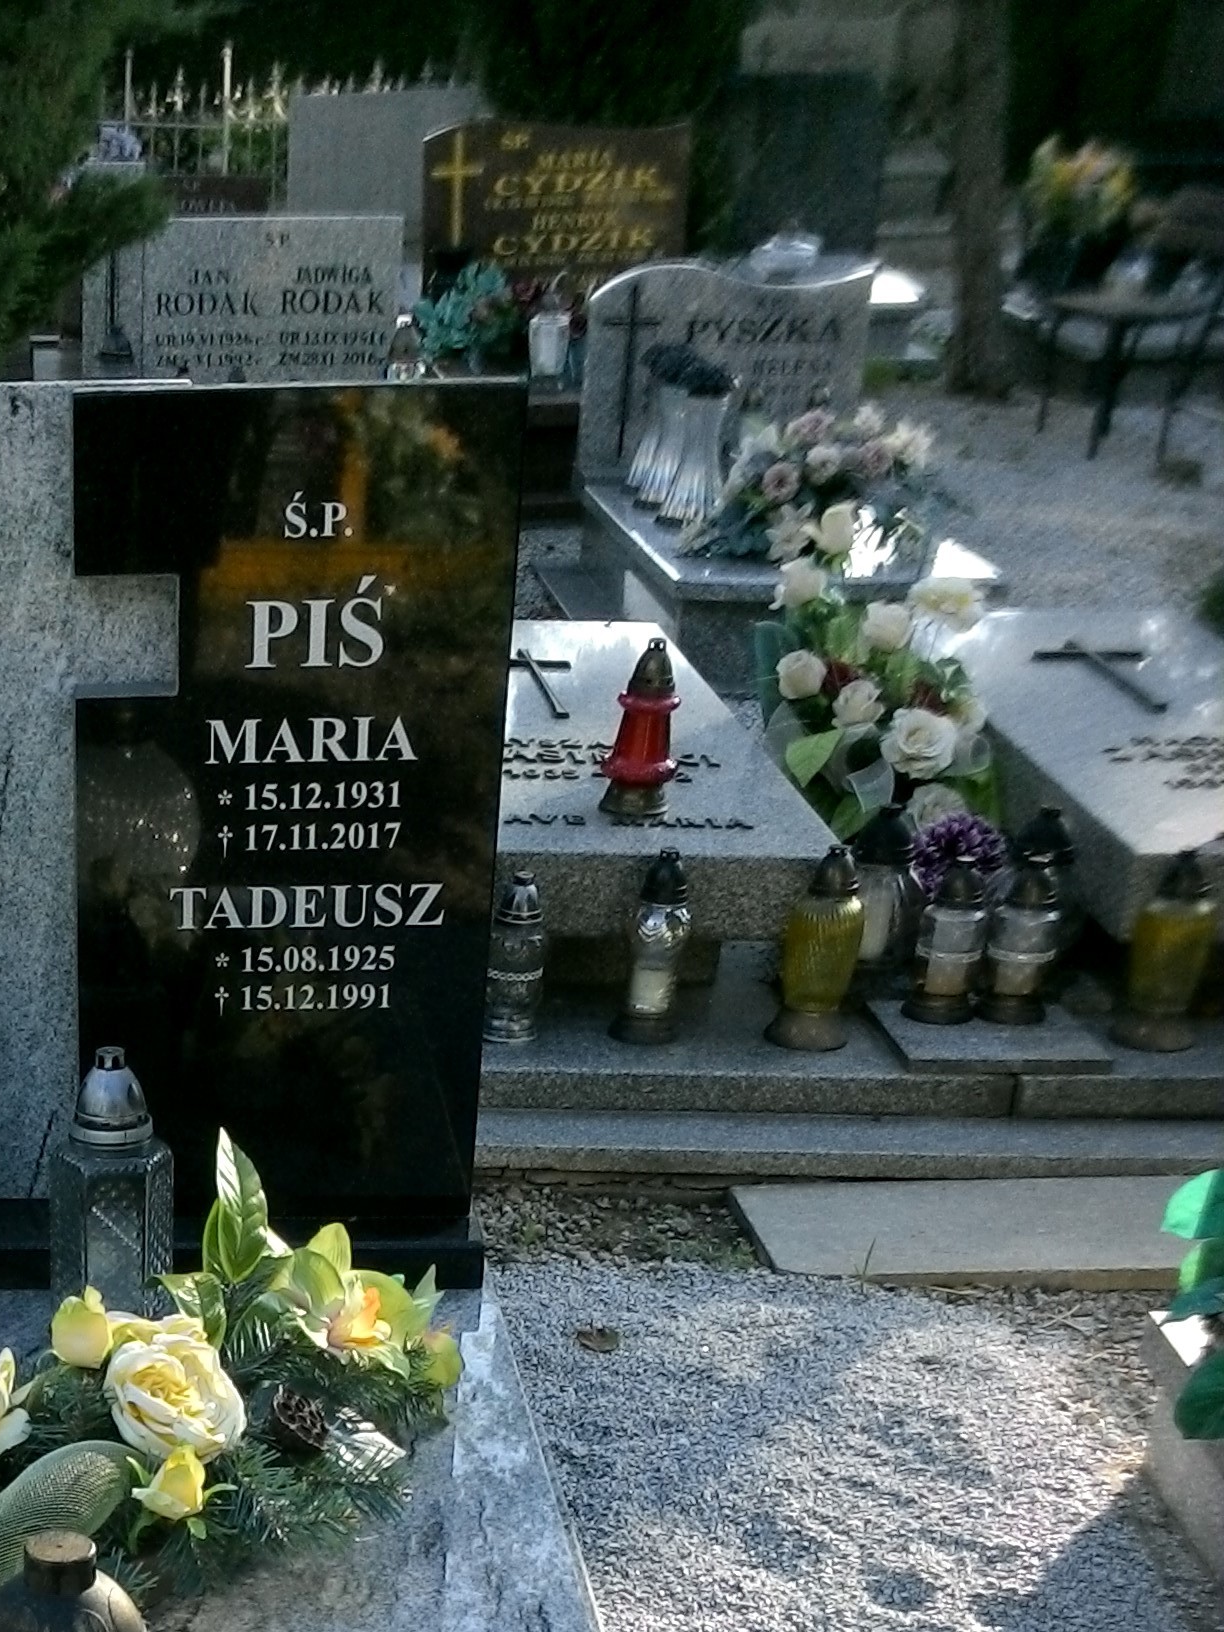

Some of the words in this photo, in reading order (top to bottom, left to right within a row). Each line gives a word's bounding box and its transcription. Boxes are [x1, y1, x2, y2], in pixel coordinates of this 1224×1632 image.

[494, 166, 659, 196] CYDZIK
[493, 228, 654, 255] CYDZIK
[189, 268, 231, 286] JAN
[295, 263, 373, 285] JADWIGA
[156, 288, 258, 317] RODAK
[281, 287, 385, 316] RODAK
[284, 490, 354, 538] Ś.P.
[244, 575, 384, 668] PIŚ
[204, 716, 419, 764] MARIA
[245, 780, 401, 811] 15.12.1931
[245, 822, 402, 851] 17.11.2017
[169, 883, 446, 930] TADEUSZ
[241, 945, 396, 973] 15.08.1925
[241, 983, 391, 1011] 15.12.1991
